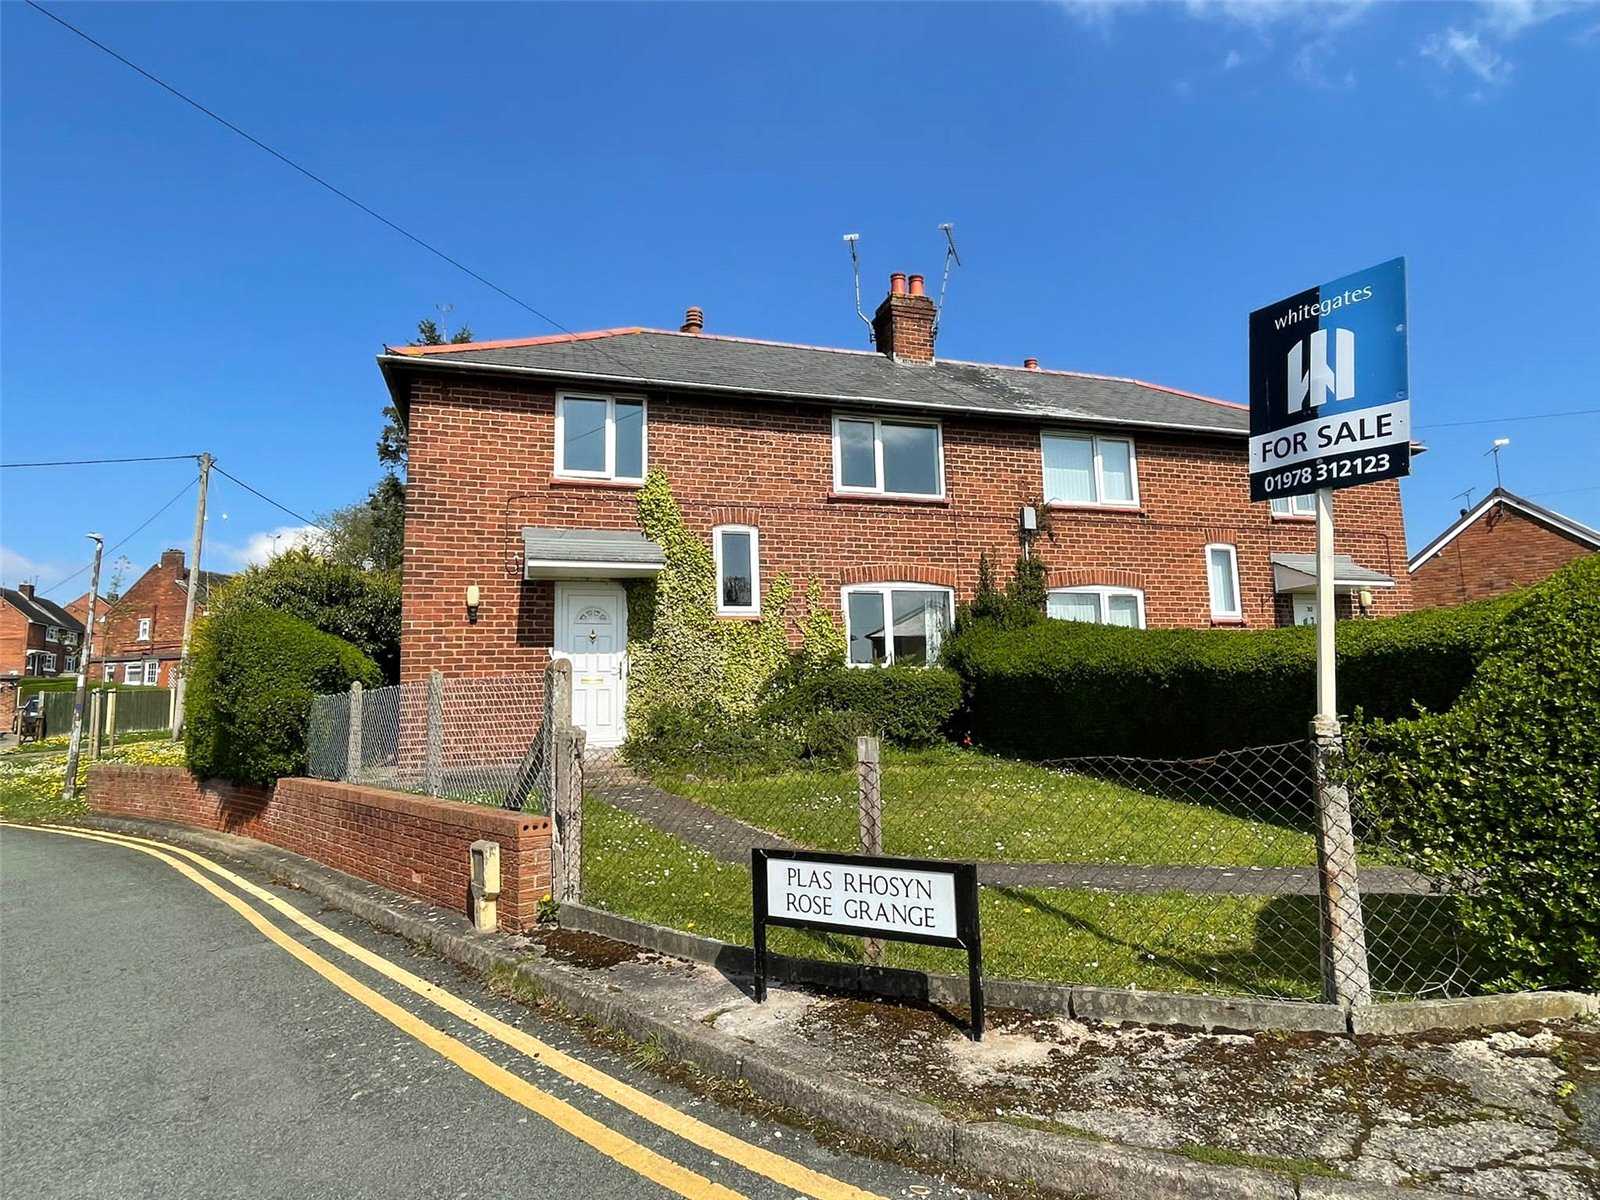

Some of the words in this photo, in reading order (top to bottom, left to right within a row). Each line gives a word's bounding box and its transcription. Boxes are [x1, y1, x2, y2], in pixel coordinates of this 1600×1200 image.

[1274, 285, 1372, 330] whitegates
[1262, 431, 1308, 463] FOR
[1318, 412, 1393, 448] SALE
[1264, 467, 1312, 492] 01978
[1316, 453, 1390, 481] 312123
[787, 867, 832, 890] PLAS
[843, 872, 932, 900] RHOSYN
[786, 893, 832, 915] ROSE
[843, 899, 936, 928] GRANGE
